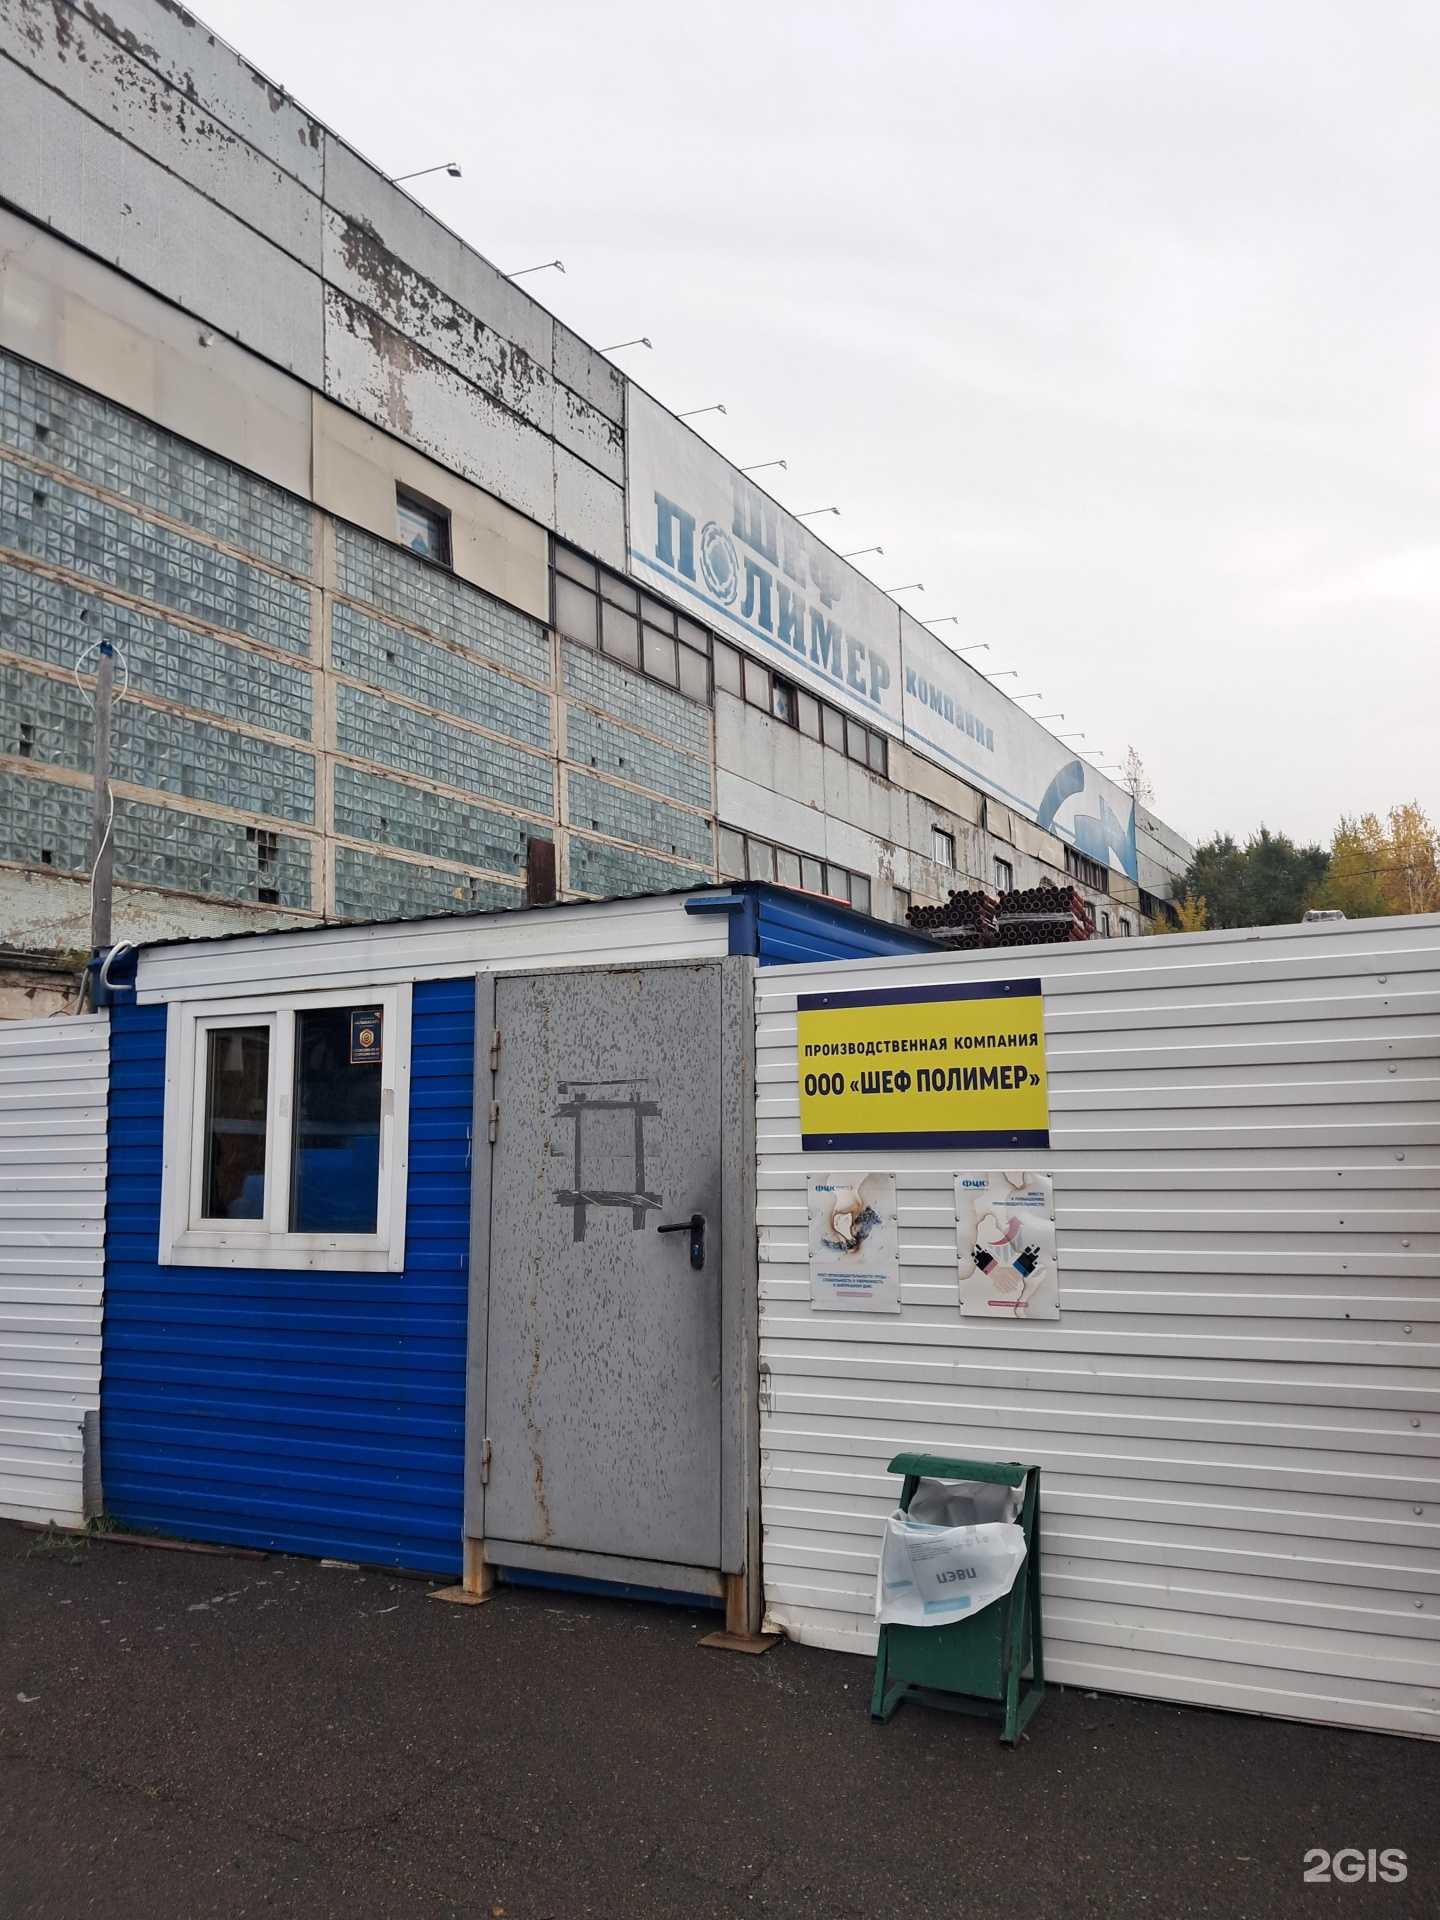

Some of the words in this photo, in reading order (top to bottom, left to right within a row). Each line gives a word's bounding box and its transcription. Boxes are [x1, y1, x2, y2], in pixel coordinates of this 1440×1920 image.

[654, 490, 891, 704] ПОЛИМЕР
[804, 1037, 948, 1057] ПРОИЗВОДСТВЕННАЯ
[954, 1033, 1039, 1050] КОМПАНИЯ
[804, 1072, 845, 1097] ООО
[850, 1070, 912, 1095] «ШЕФ
[916, 1065, 1040, 1093] ПОЛИМЕР»
